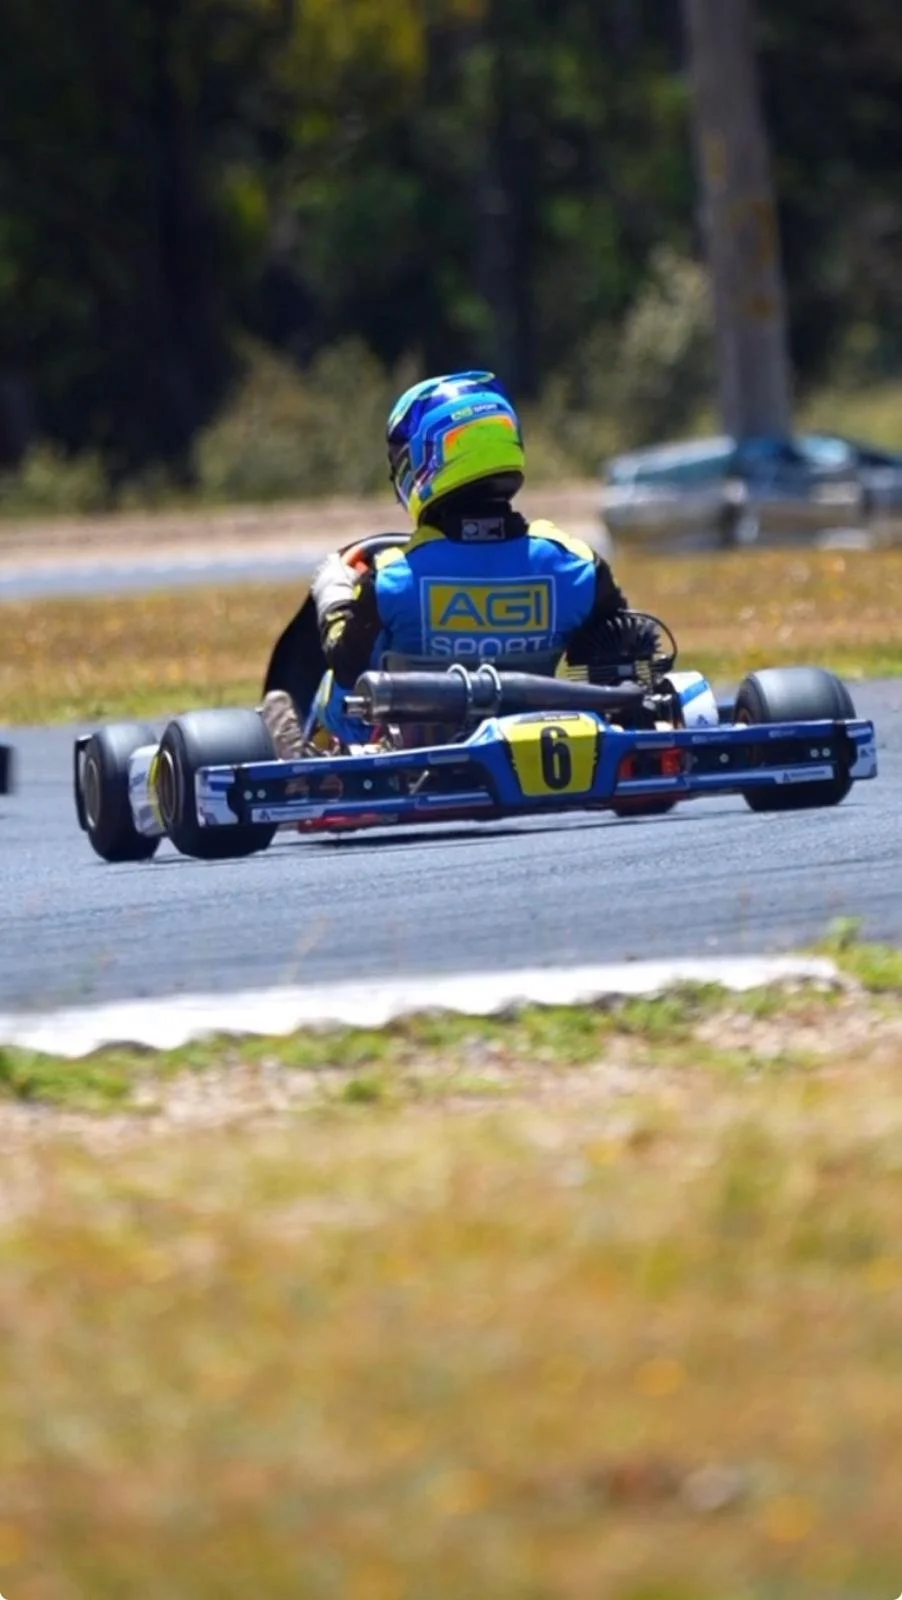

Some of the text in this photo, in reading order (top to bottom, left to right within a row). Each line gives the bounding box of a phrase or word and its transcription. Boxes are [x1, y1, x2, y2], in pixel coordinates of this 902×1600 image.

[438, 590, 543, 626] AGI
[430, 636, 547, 657] SPORT
[540, 726, 572, 790] 6
